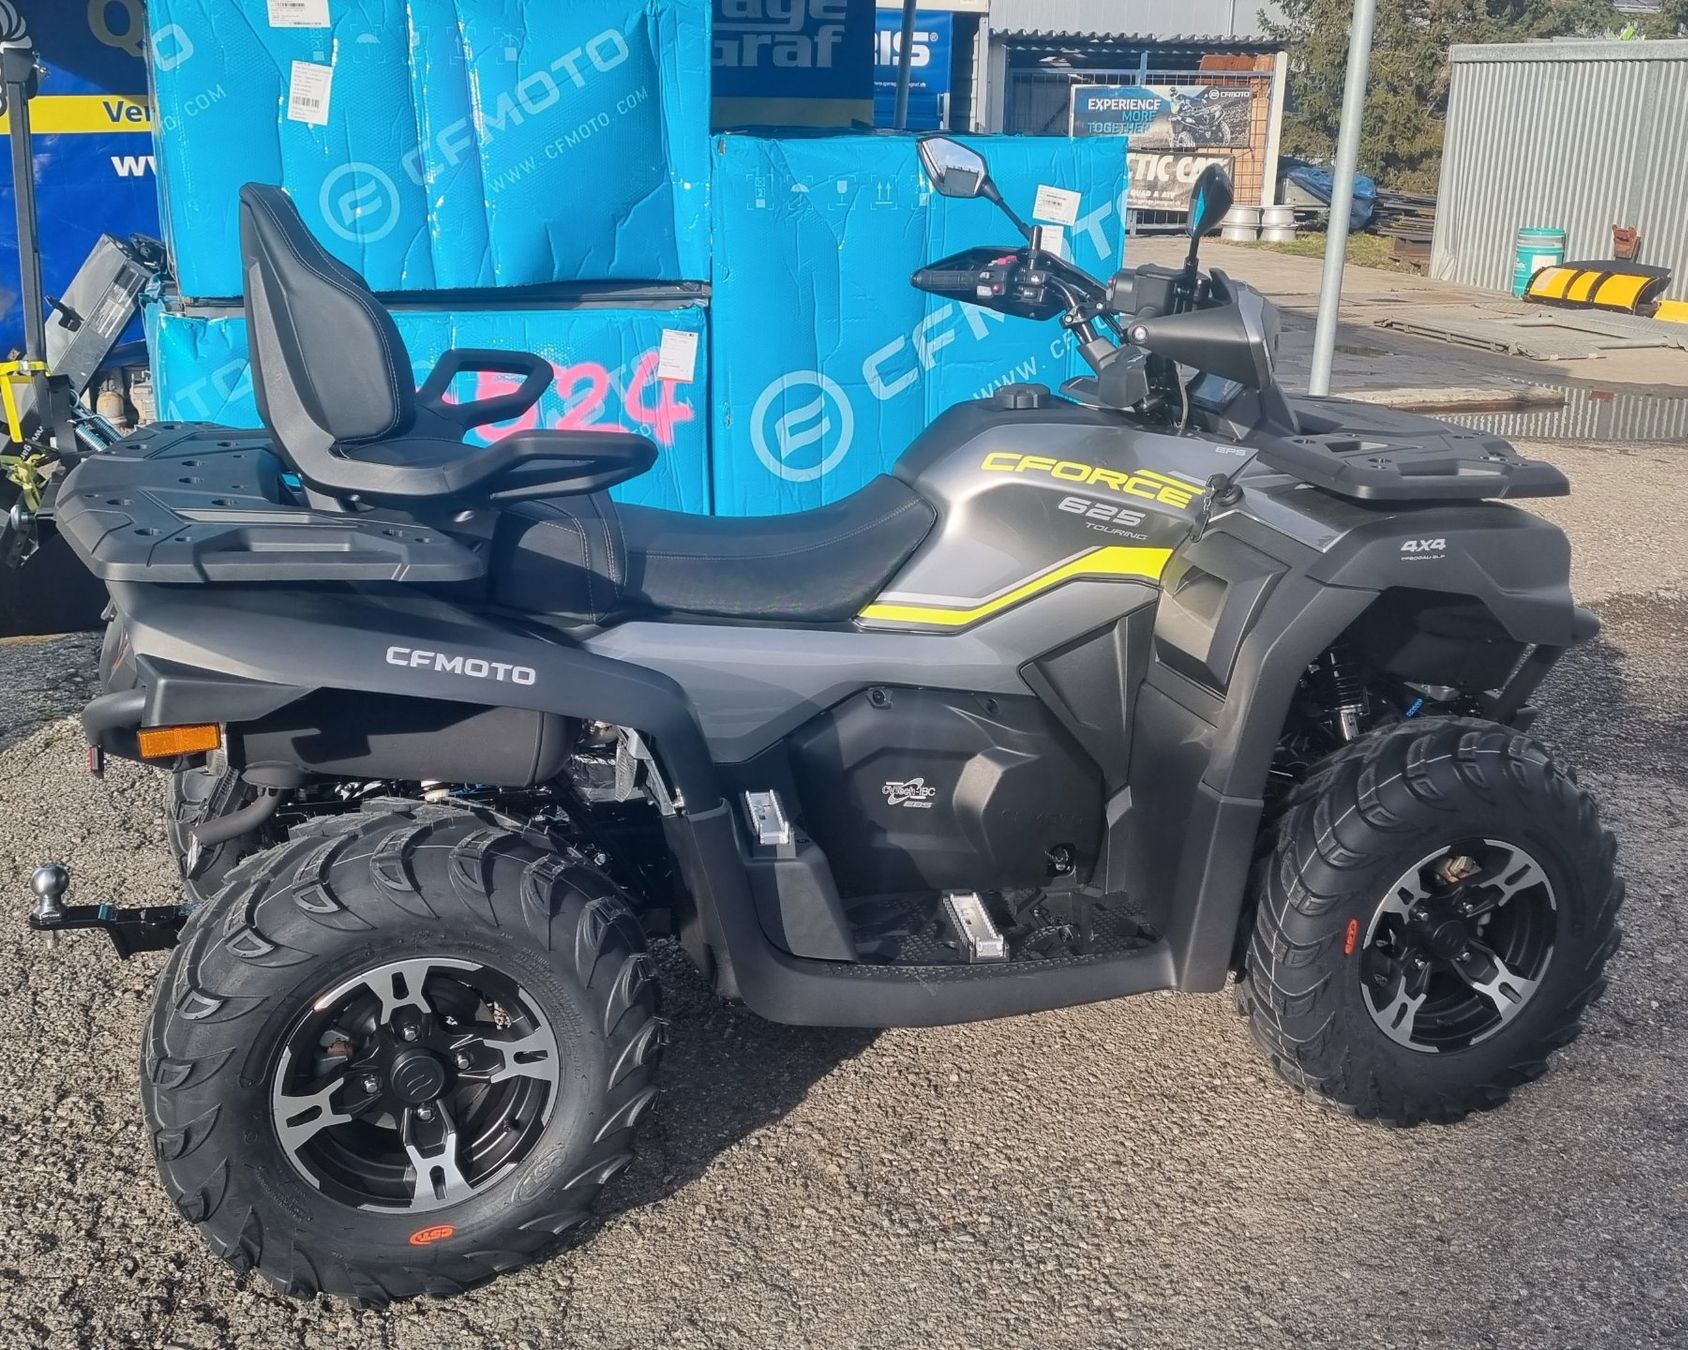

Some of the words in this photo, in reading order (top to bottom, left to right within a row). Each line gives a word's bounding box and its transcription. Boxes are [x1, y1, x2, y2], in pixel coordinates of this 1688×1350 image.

[402, 27, 629, 187] CFMOTO
[1088, 98, 1161, 111] EXPERIENCE
[1122, 110, 1157, 122] MORE
[1087, 121, 1153, 134] TOGETHER
[1215, 446, 1247, 457] EPS
[981, 452, 1205, 509] CFORCE
[1057, 496, 1146, 528] 625
[1085, 521, 1149, 541] TOURING
[386, 646, 536, 686] CFMOTO
